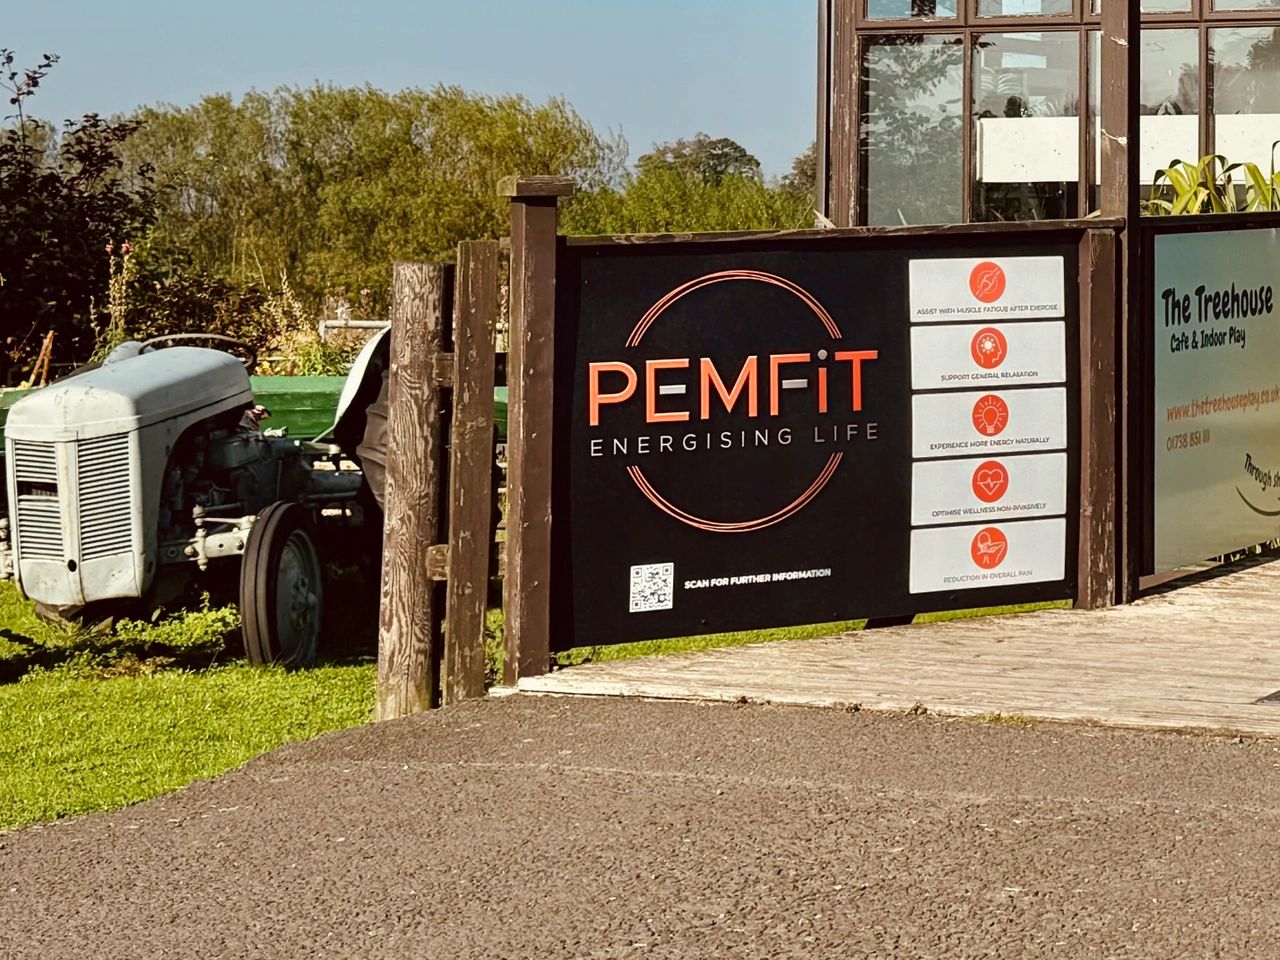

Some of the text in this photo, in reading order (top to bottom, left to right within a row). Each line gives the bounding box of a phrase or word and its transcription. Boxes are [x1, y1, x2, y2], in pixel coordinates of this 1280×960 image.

[957, 306, 981, 314] MUSCLE
[1161, 282, 1273, 327] The Treehouse
[1191, 330, 1199, 349] &
[1200, 327, 1228, 349] Indoor
[1229, 325, 1246, 349] Play
[941, 370, 1038, 381] SUPPORT GENERAL RELAXATION
[1167, 384, 1280, 422] www.thetreehouseplay.co.uk
[590, 423, 879, 456] ENERGISING LIFE
[930, 441, 969, 450] EXPERIENCE
[970, 440, 988, 448] MORE
[989, 439, 1014, 447] ENERGY
[1244, 452, 1272, 491] Through
[932, 509, 961, 517] OPTIMISE
[962, 506, 996, 515] WELLNESS
[684, 568, 831, 589] SCAN FOR FURTHER INFORMATION
[944, 574, 980, 583] REDUCTION
[989, 571, 1017, 579] OVERALL
